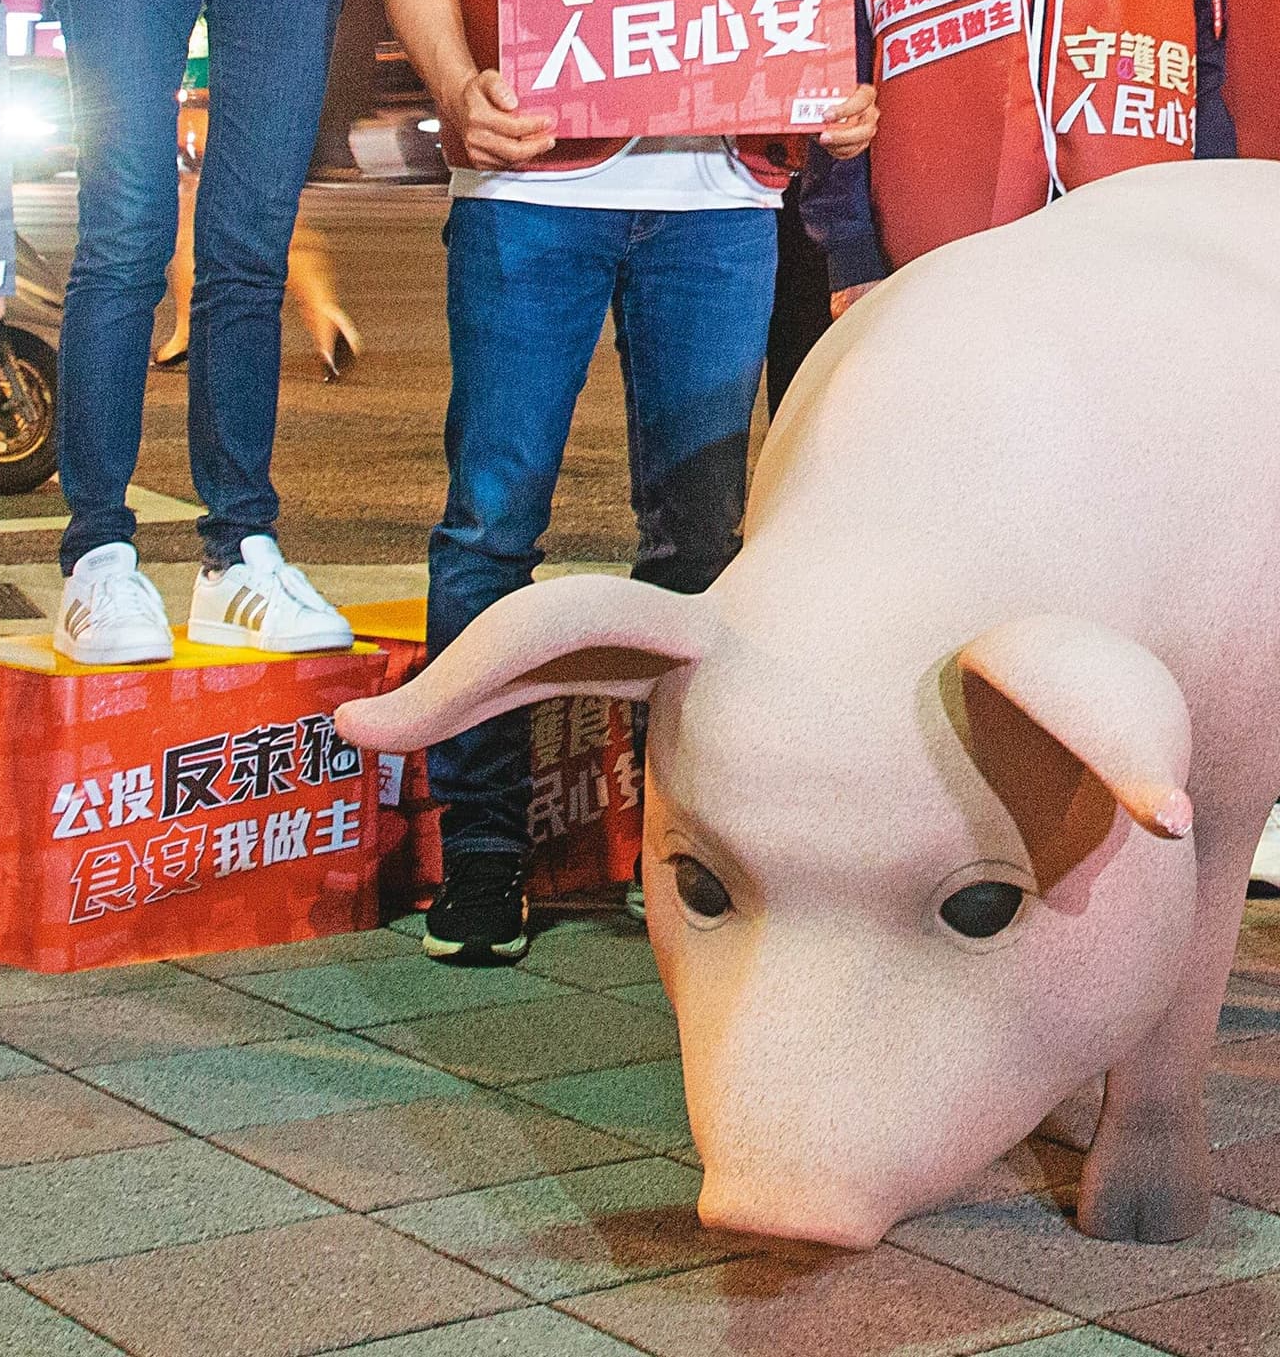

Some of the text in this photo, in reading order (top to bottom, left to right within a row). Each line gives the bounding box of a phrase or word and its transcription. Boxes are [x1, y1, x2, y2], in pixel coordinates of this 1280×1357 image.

[1063, 26, 1197, 100] 守護食
[1055, 82, 1197, 155] 人民心
[51, 712, 363, 840] 公投反萊豬
[69, 799, 361, 925] 食安我做主
